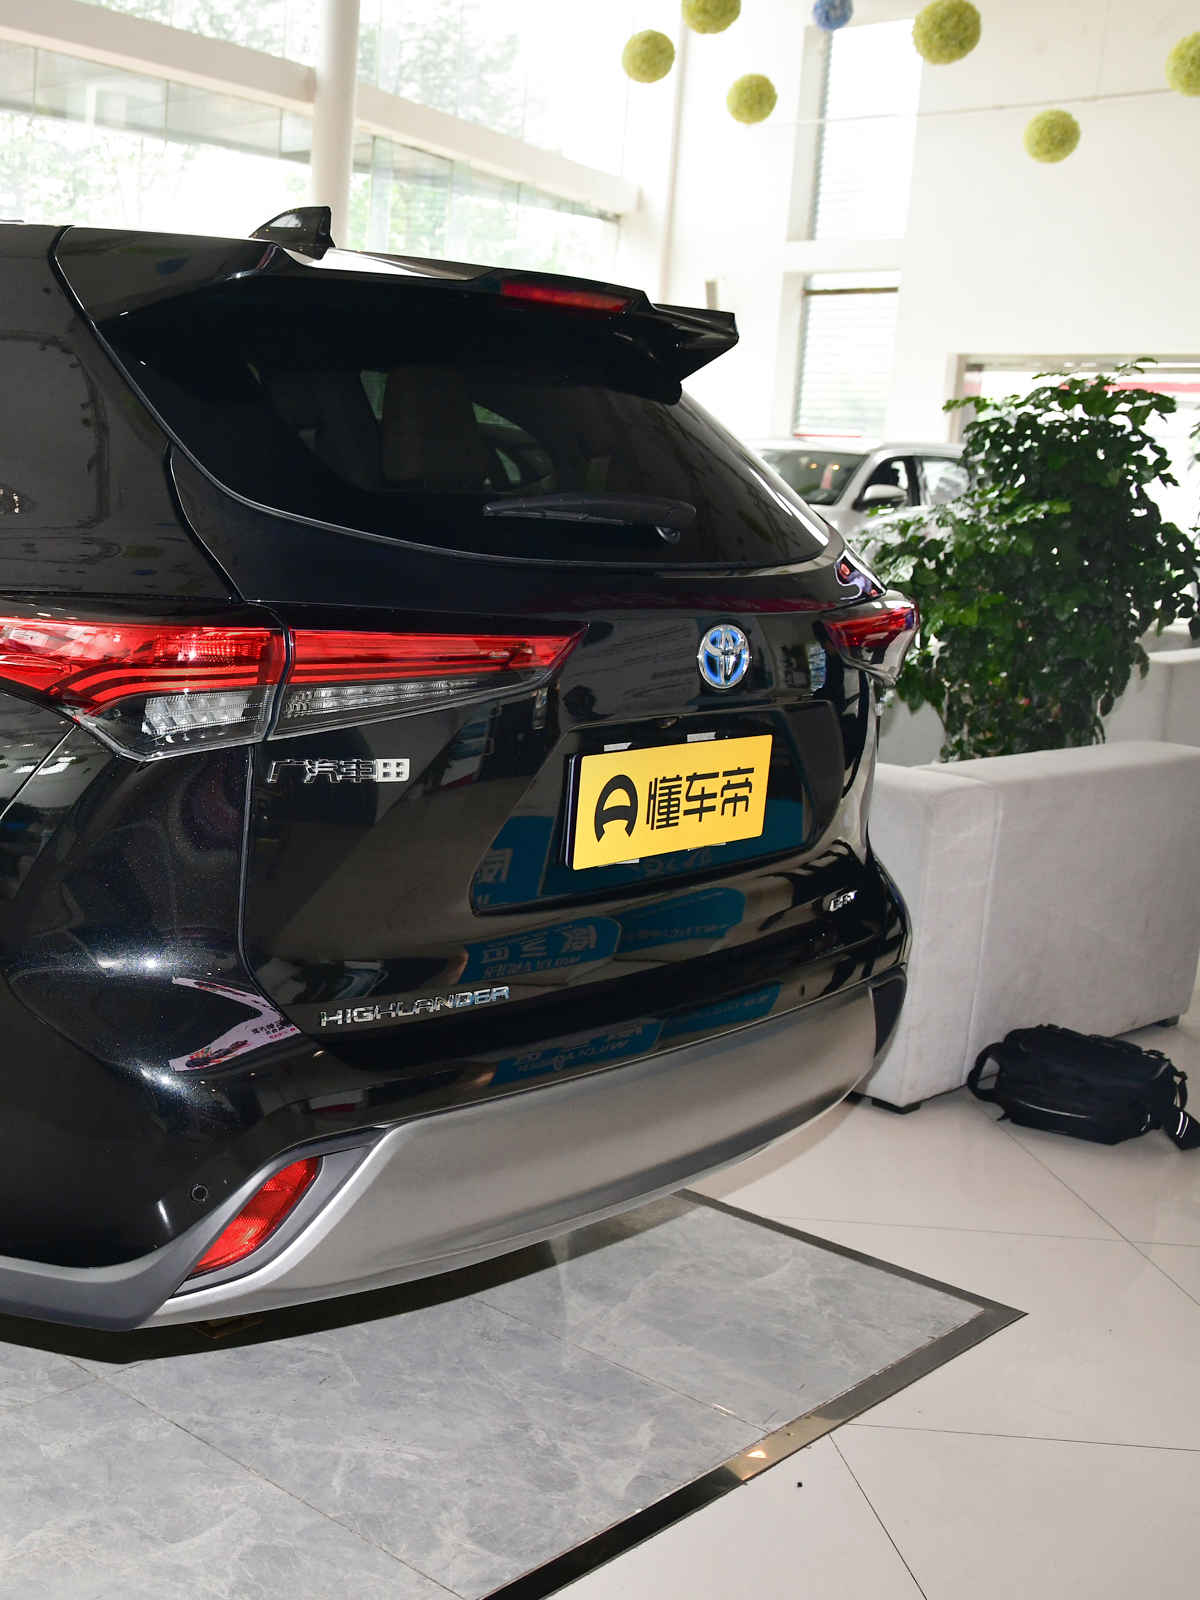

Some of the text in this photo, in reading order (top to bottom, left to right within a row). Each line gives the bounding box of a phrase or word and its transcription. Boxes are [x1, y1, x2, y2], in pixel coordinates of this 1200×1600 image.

[267, 758, 410, 783] 广汽丰田
[646, 767, 754, 831] 懂车帝
[319, 985, 510, 1027] HIGHLANDER
